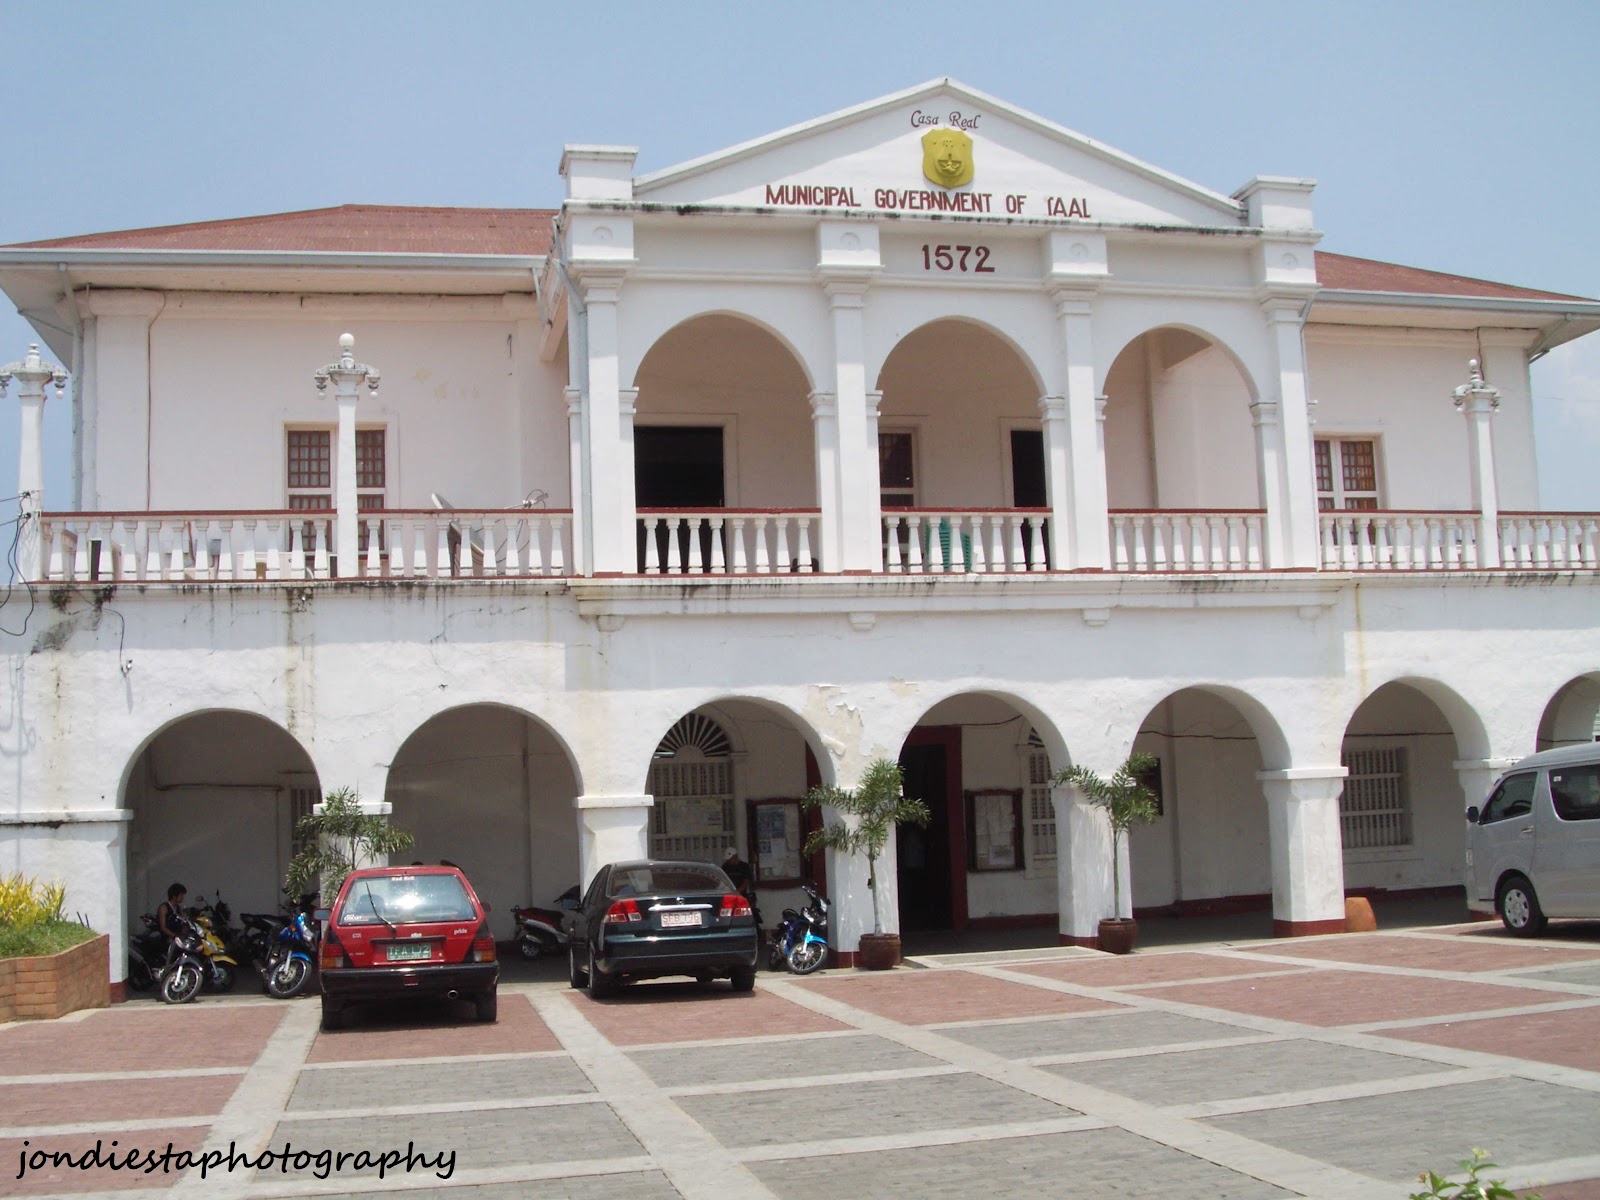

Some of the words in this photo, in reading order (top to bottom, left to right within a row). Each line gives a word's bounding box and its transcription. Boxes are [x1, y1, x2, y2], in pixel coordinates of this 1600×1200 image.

[911, 110, 939, 128] Casa
[949, 111, 981, 131] Real
[766, 184, 861, 208] MUNICIPAL
[875, 188, 992, 213] GOVERNMENT
[1006, 195, 1027, 215] OF
[1047, 196, 1091, 218] TAAL
[922, 244, 996, 273] 1572
